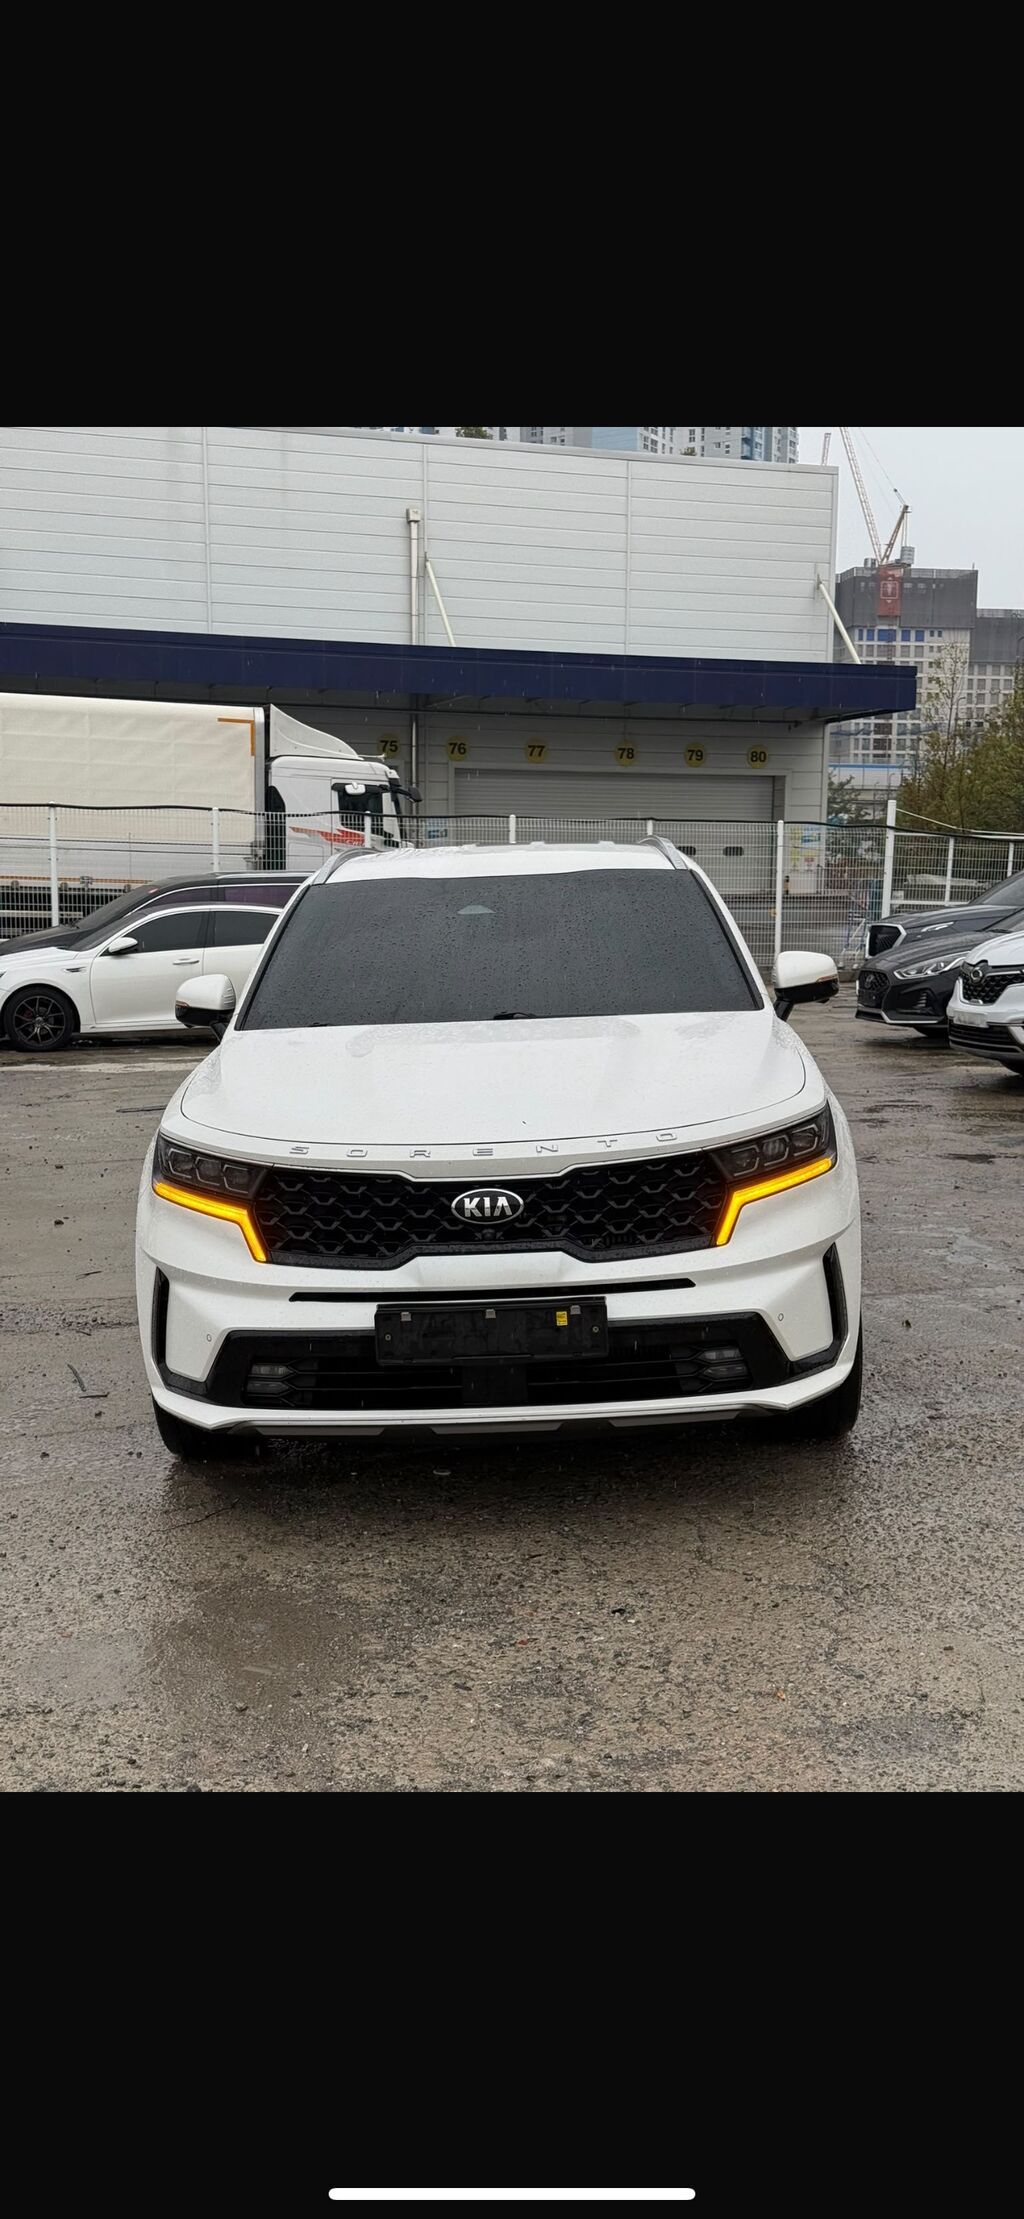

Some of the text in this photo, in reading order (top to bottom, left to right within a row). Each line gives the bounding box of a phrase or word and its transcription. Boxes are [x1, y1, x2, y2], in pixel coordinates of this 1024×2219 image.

[380, 740, 398, 752] 75
[449, 742, 466, 754] 76
[528, 745, 545, 757] 77
[618, 748, 634, 759] 78
[688, 749, 703, 761] 79
[751, 751, 766, 762] 80
[289, 1132, 678, 1157] SORENTO
[464, 1196, 512, 1217] KIA
